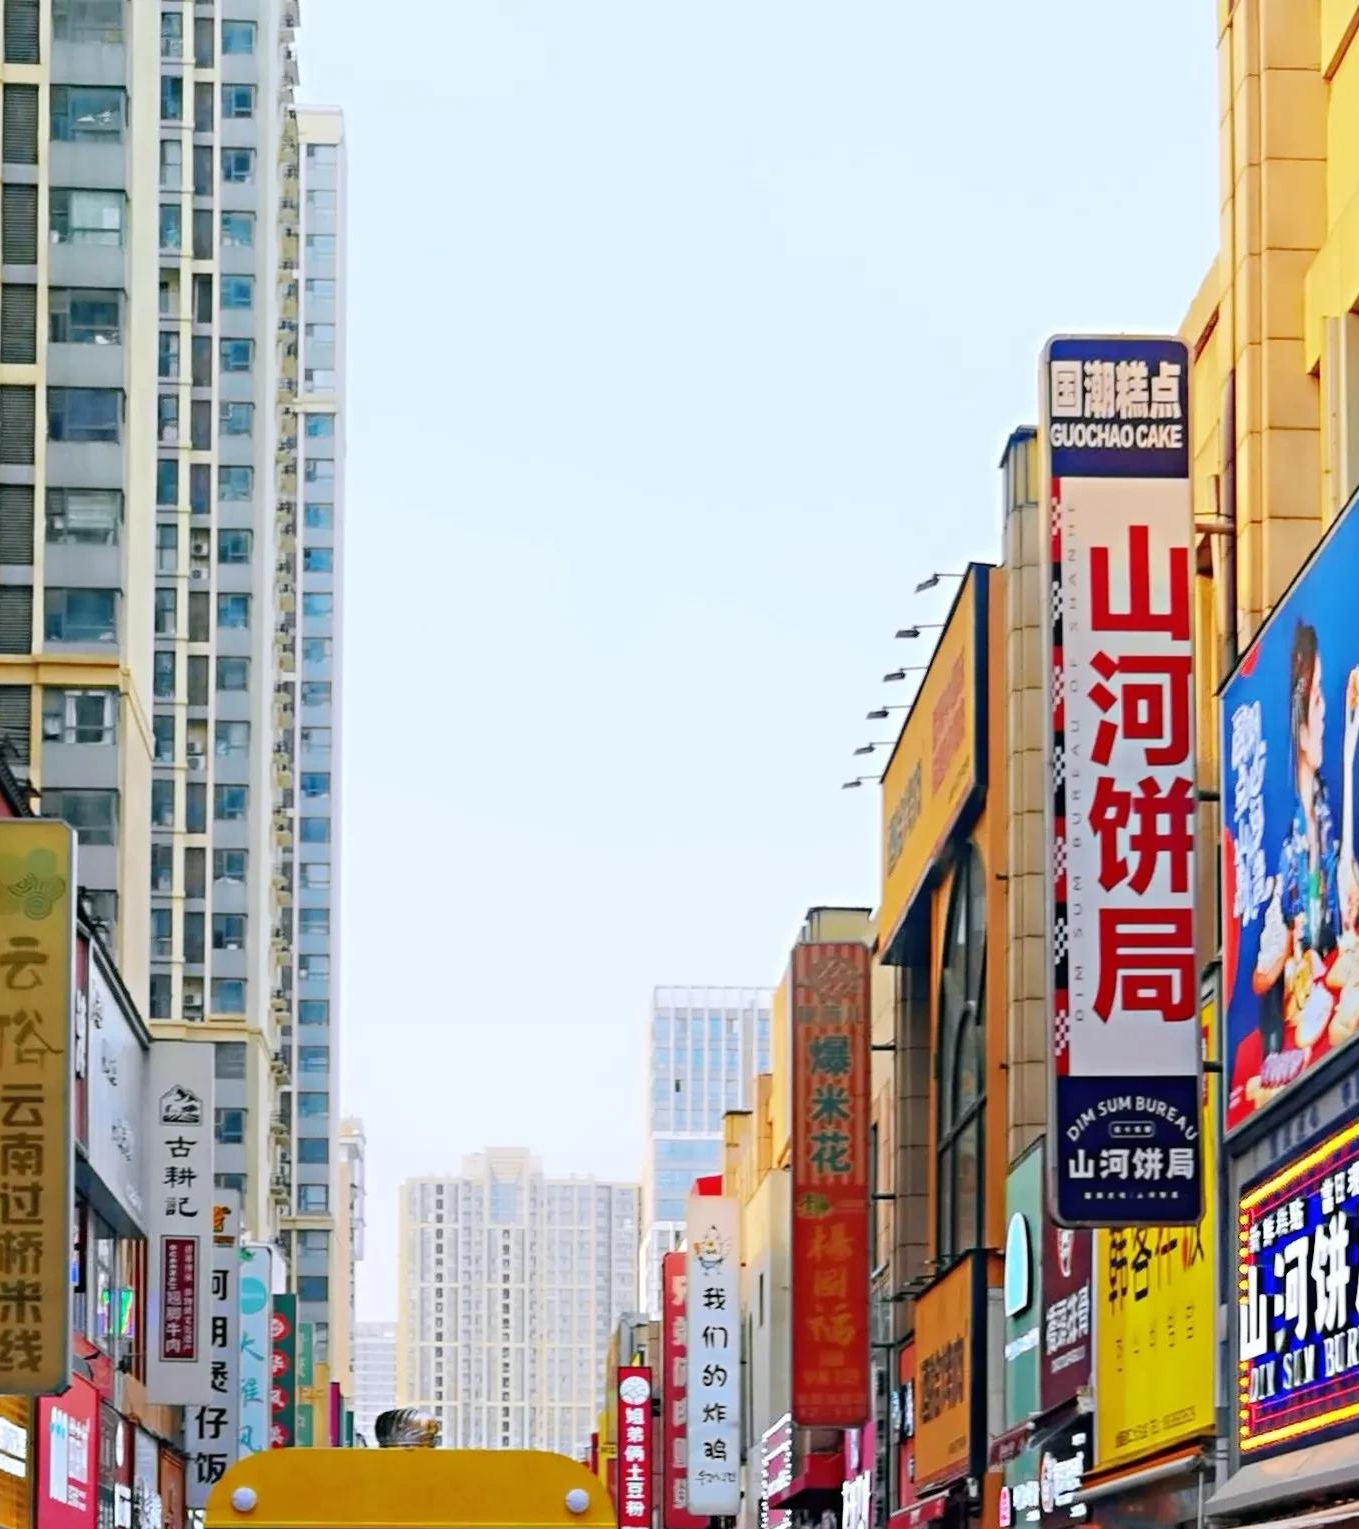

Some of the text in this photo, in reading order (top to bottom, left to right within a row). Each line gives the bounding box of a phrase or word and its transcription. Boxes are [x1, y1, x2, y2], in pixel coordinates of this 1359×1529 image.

[1050, 359, 1182, 419] 国潮糕点
[1050, 423, 1183, 449] GUOCHAO CAKE
[1072, 720, 1082, 849] BUREAU
[1088, 525, 1196, 1024] 山河饼局
[1073, 876, 1083, 938] SUM
[1074, 965, 1084, 1021] DIM
[809, 1033, 852, 1175] 爆米花
[1066, 1096, 1198, 1141] DIM SUM BUREAU
[1068, 1147, 1194, 1180] 山河饼局
[701, 1287, 729, 1462] 我们的炸鸡
